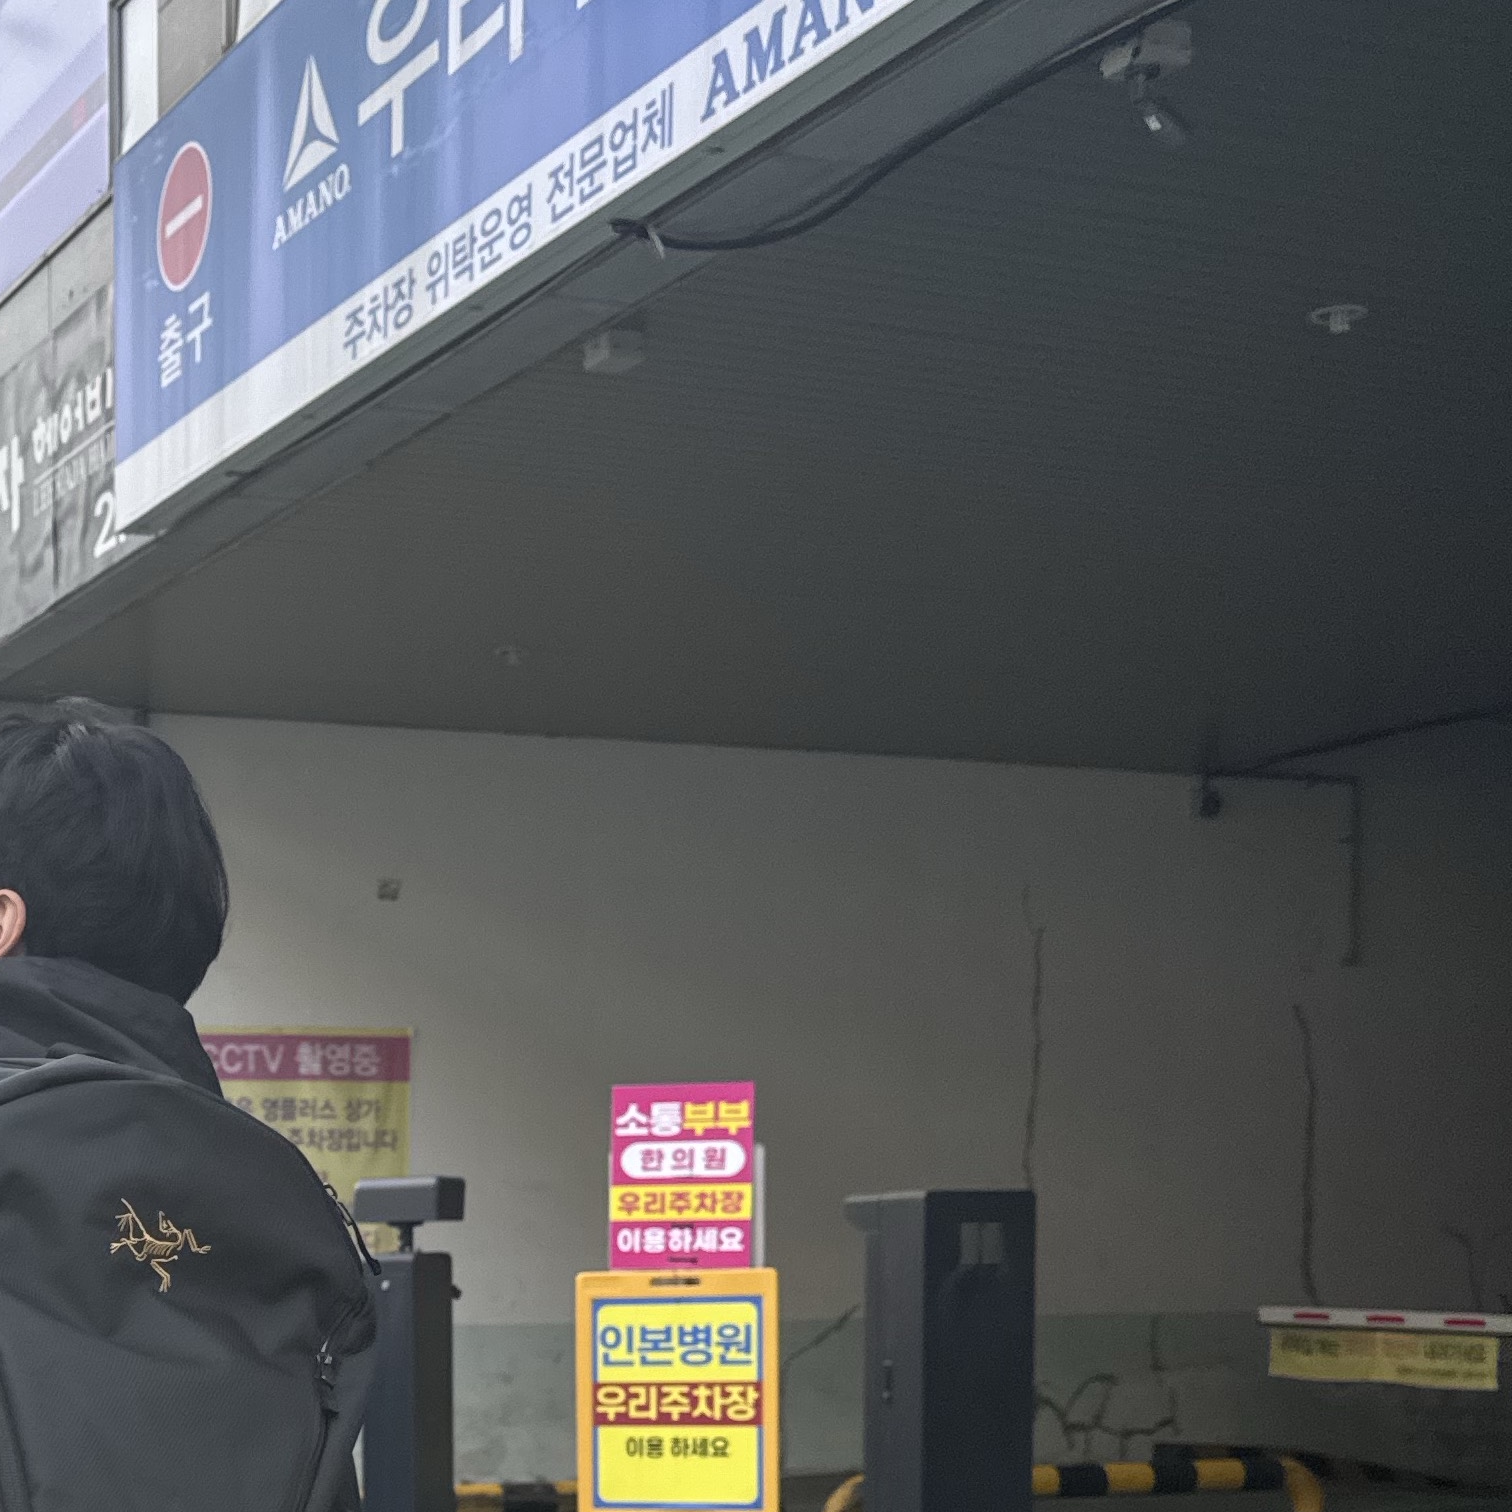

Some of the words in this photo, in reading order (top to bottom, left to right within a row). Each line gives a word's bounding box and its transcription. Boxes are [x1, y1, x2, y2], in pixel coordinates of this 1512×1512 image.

[358, 0, 588, 158] 우리
[271, 162, 350, 251] AMANO
[343, 268, 415, 360] 주차장
[426, 183, 534, 305] 위탁운영
[547, 82, 675, 224] 전문업체
[157, 291, 214, 388] 출구
[614, 1100, 752, 1138] 소통부부
[617, 1190, 745, 1216] 우리주차장
[616, 1225, 745, 1254] 이용하세요
[599, 1322, 754, 1368] 인본병원
[595, 1384, 760, 1422] 우리주차장
[625, 1436, 665, 1460] 이용
[670, 1436, 731, 1460] 하세요
